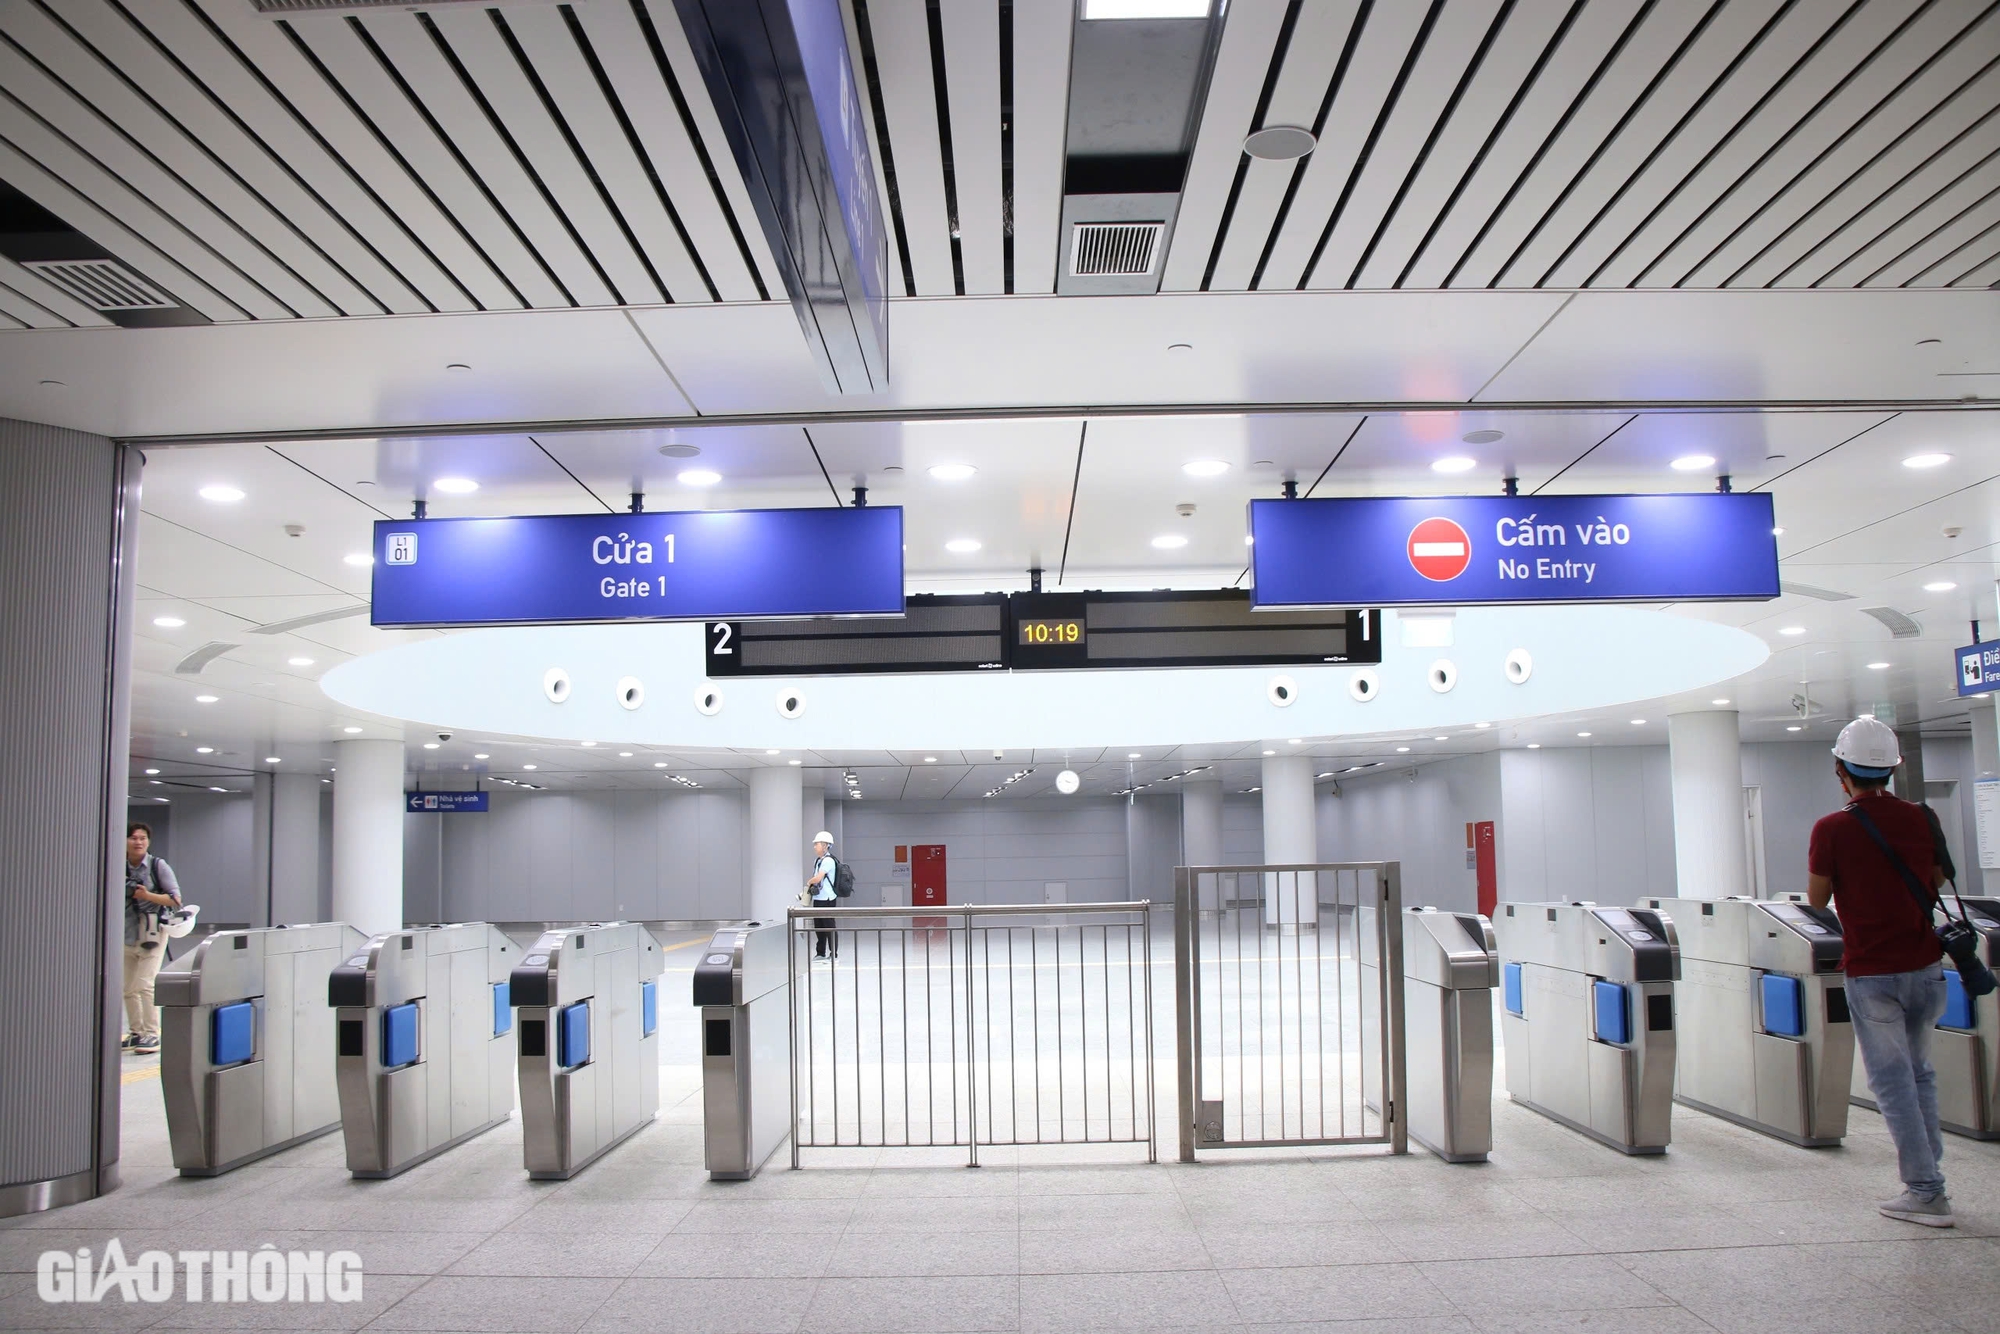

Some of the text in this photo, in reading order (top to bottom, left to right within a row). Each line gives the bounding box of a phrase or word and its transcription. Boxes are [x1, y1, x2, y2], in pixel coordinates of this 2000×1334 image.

[850, 177, 861, 248] Line
[396, 537, 407, 546] L1
[1496, 513, 1631, 547] Cấm vào
[394, 547, 408, 561] 01
[592, 532, 675, 565] Cửa 1
[1498, 558, 1596, 584] No Entry
[600, 575, 666, 598] Gate 1
[713, 622, 733, 655] 2
[1024, 623, 1079, 643] 10:19
[1358, 608, 1370, 641] 1
